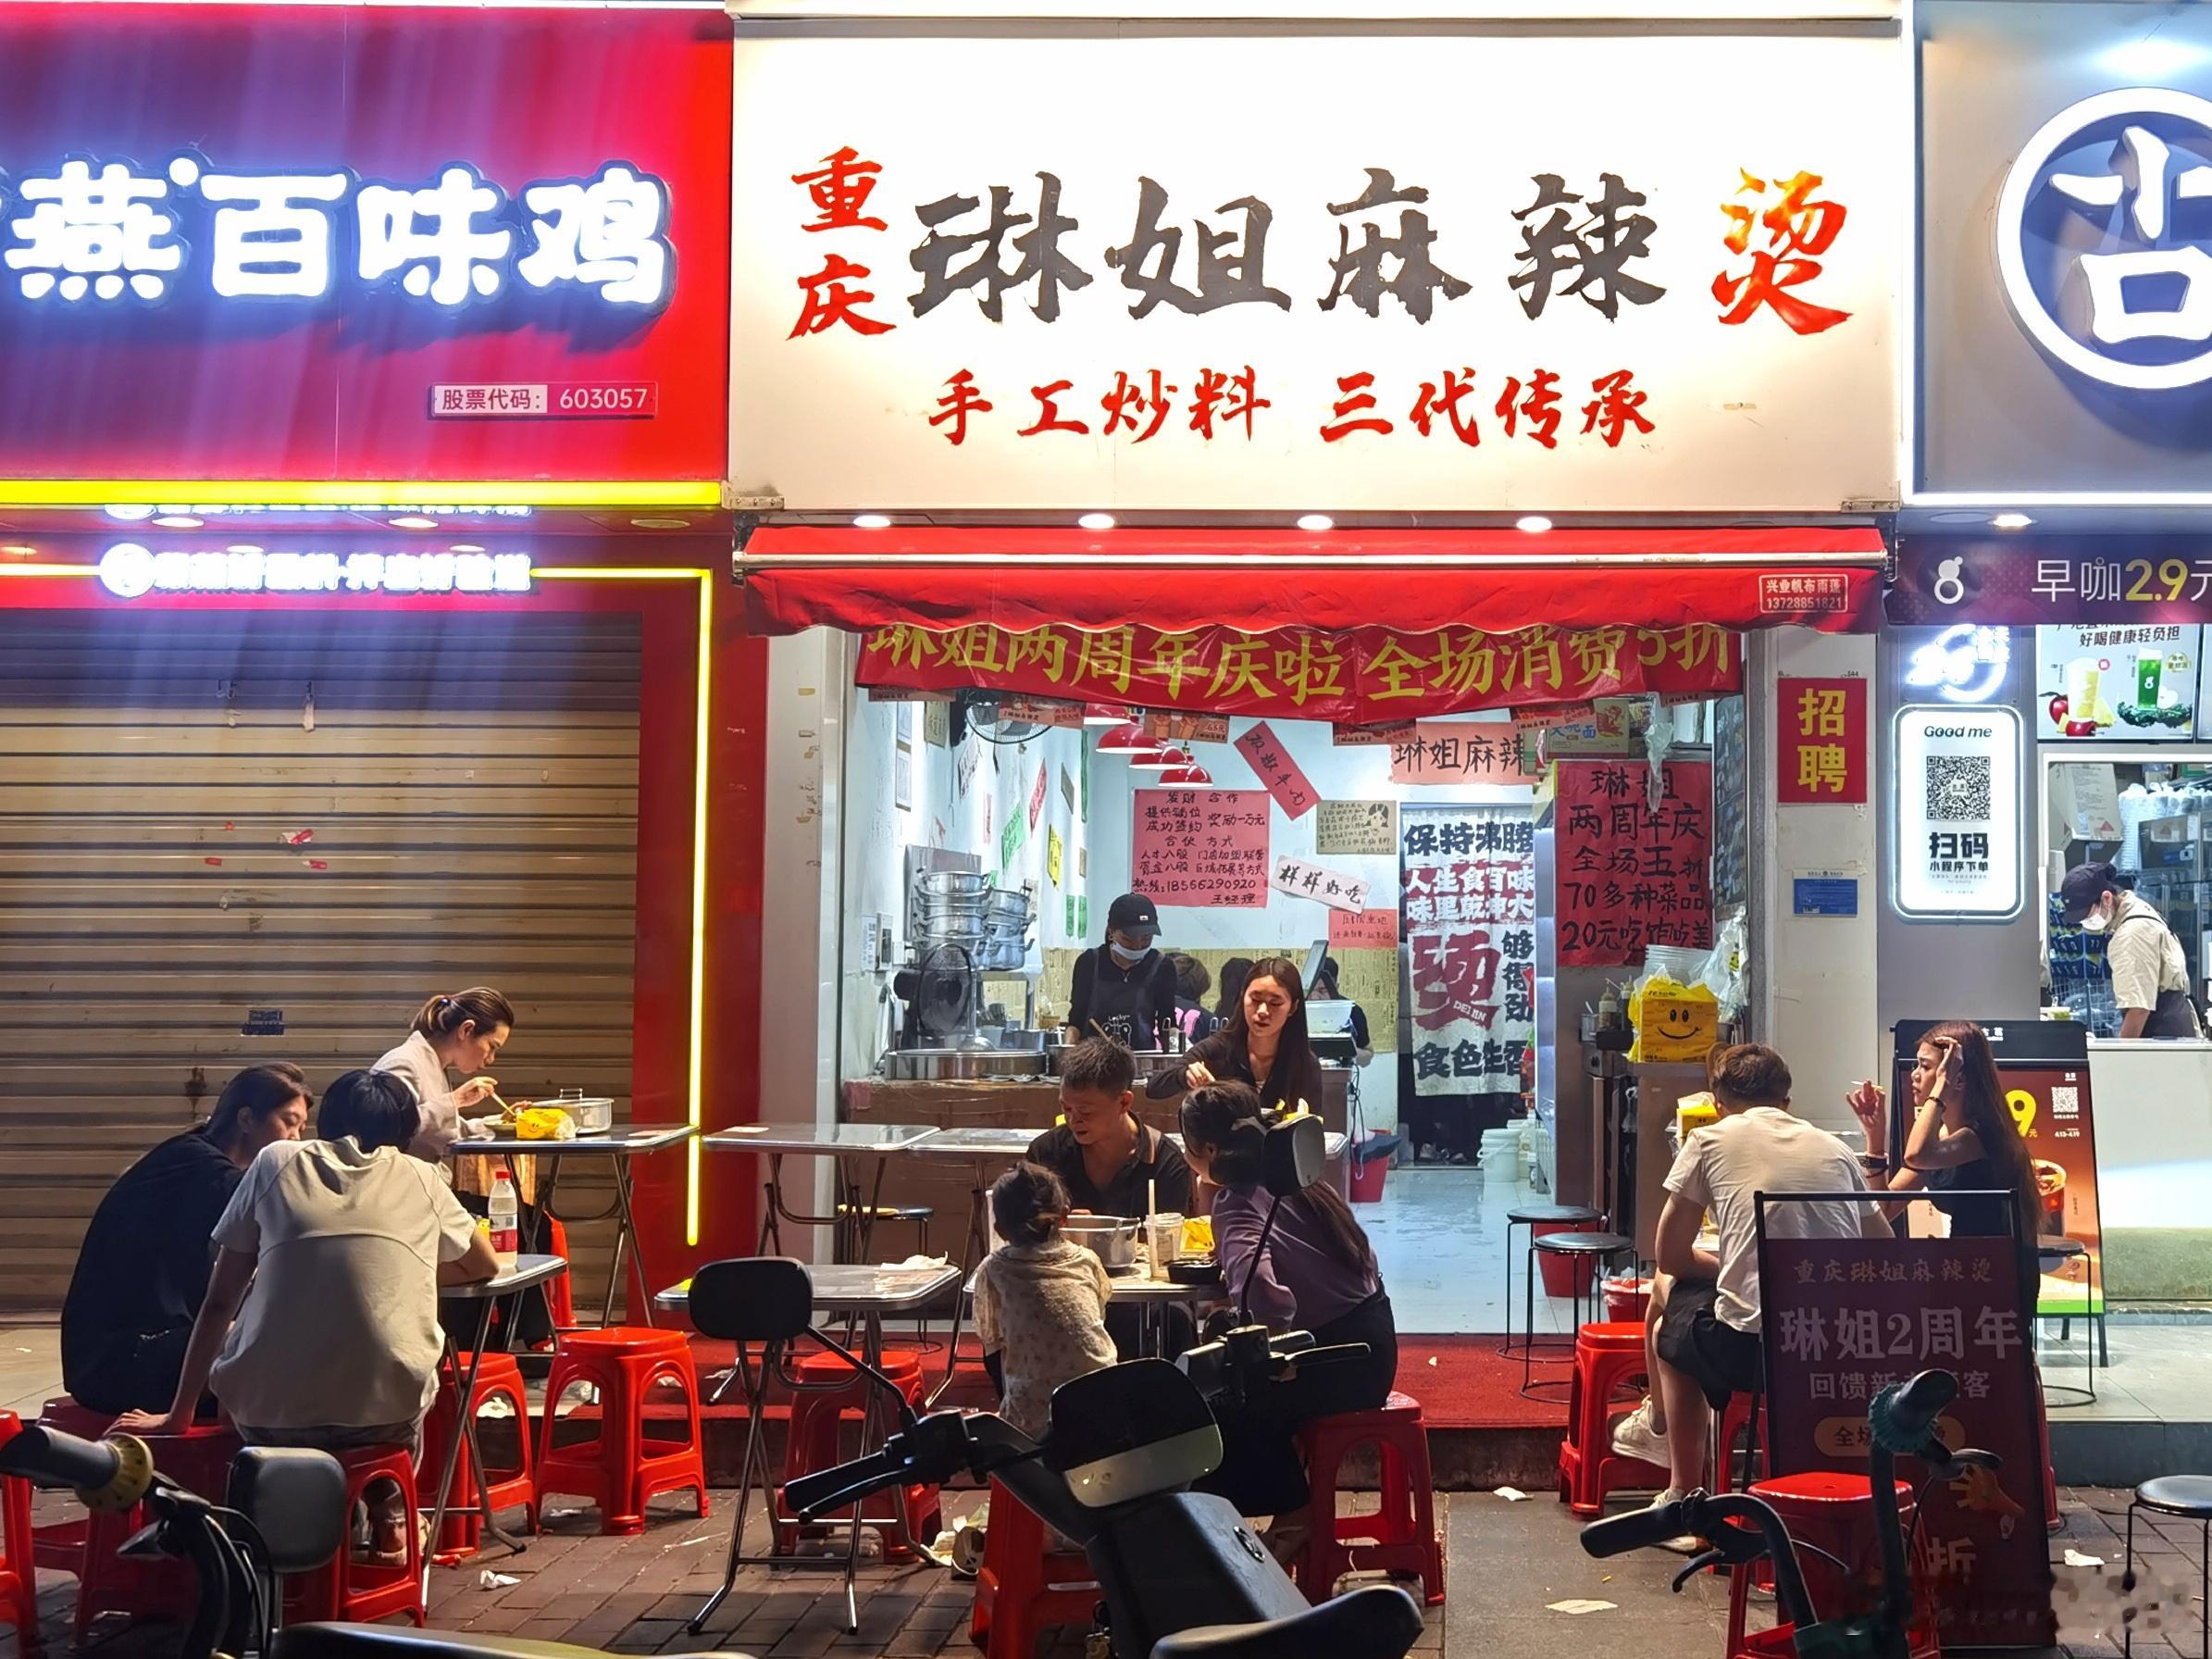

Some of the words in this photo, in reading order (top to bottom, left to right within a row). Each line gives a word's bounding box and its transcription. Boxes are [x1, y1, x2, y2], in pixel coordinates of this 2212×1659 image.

[786, 146, 897, 341] 重庆
[907, 167, 1854, 335] 琳姐麻辣烫
[558, 388, 648, 409] 603057
[928, 364, 1272, 446] 手工炒料
[1320, 367, 1656, 449] 三代传承
[2079, 625, 2181, 648] 好喝健康轻负担
[1797, 688, 1848, 793] 招聘
[1924, 726, 1965, 738] Good
[1968, 728, 1993, 738] me
[1929, 831, 1989, 859] 扫码
[1930, 861, 1989, 872] 小程序下单
[1279, 865, 1361, 904] 样样好吃
[1793, 1258, 1994, 1284] 重庆琳姐麻辣烫
[1779, 1304, 2023, 1362] 琳姐2周年
[1809, 1370, 1992, 1401] 回馈新客
